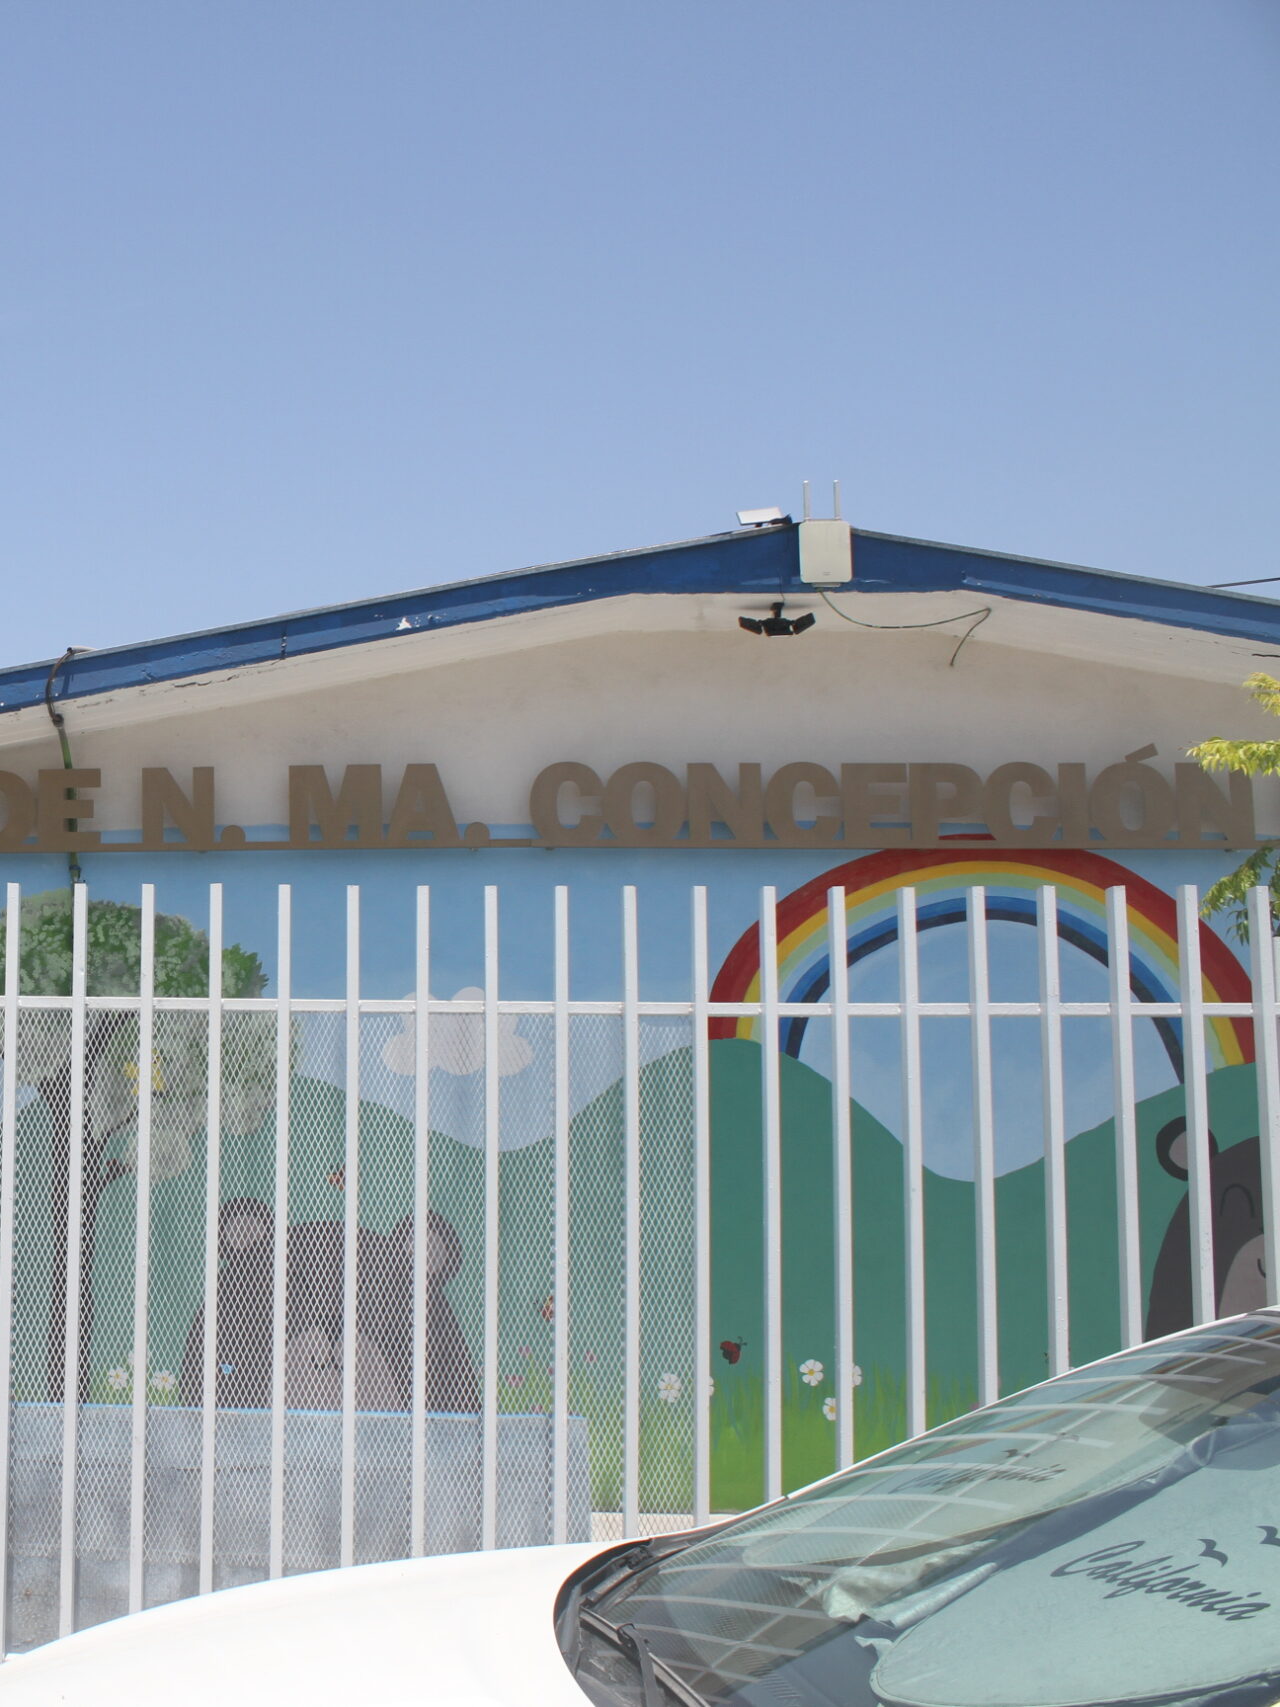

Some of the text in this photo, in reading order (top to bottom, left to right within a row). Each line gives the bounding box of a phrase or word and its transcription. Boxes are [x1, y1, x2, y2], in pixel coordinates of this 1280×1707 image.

[142, 766, 245, 845] N.
[288, 763, 490, 843] MA.
[529, 744, 1256, 842] CONCEPCIÓN
[1050, 1540, 1271, 1621] California
